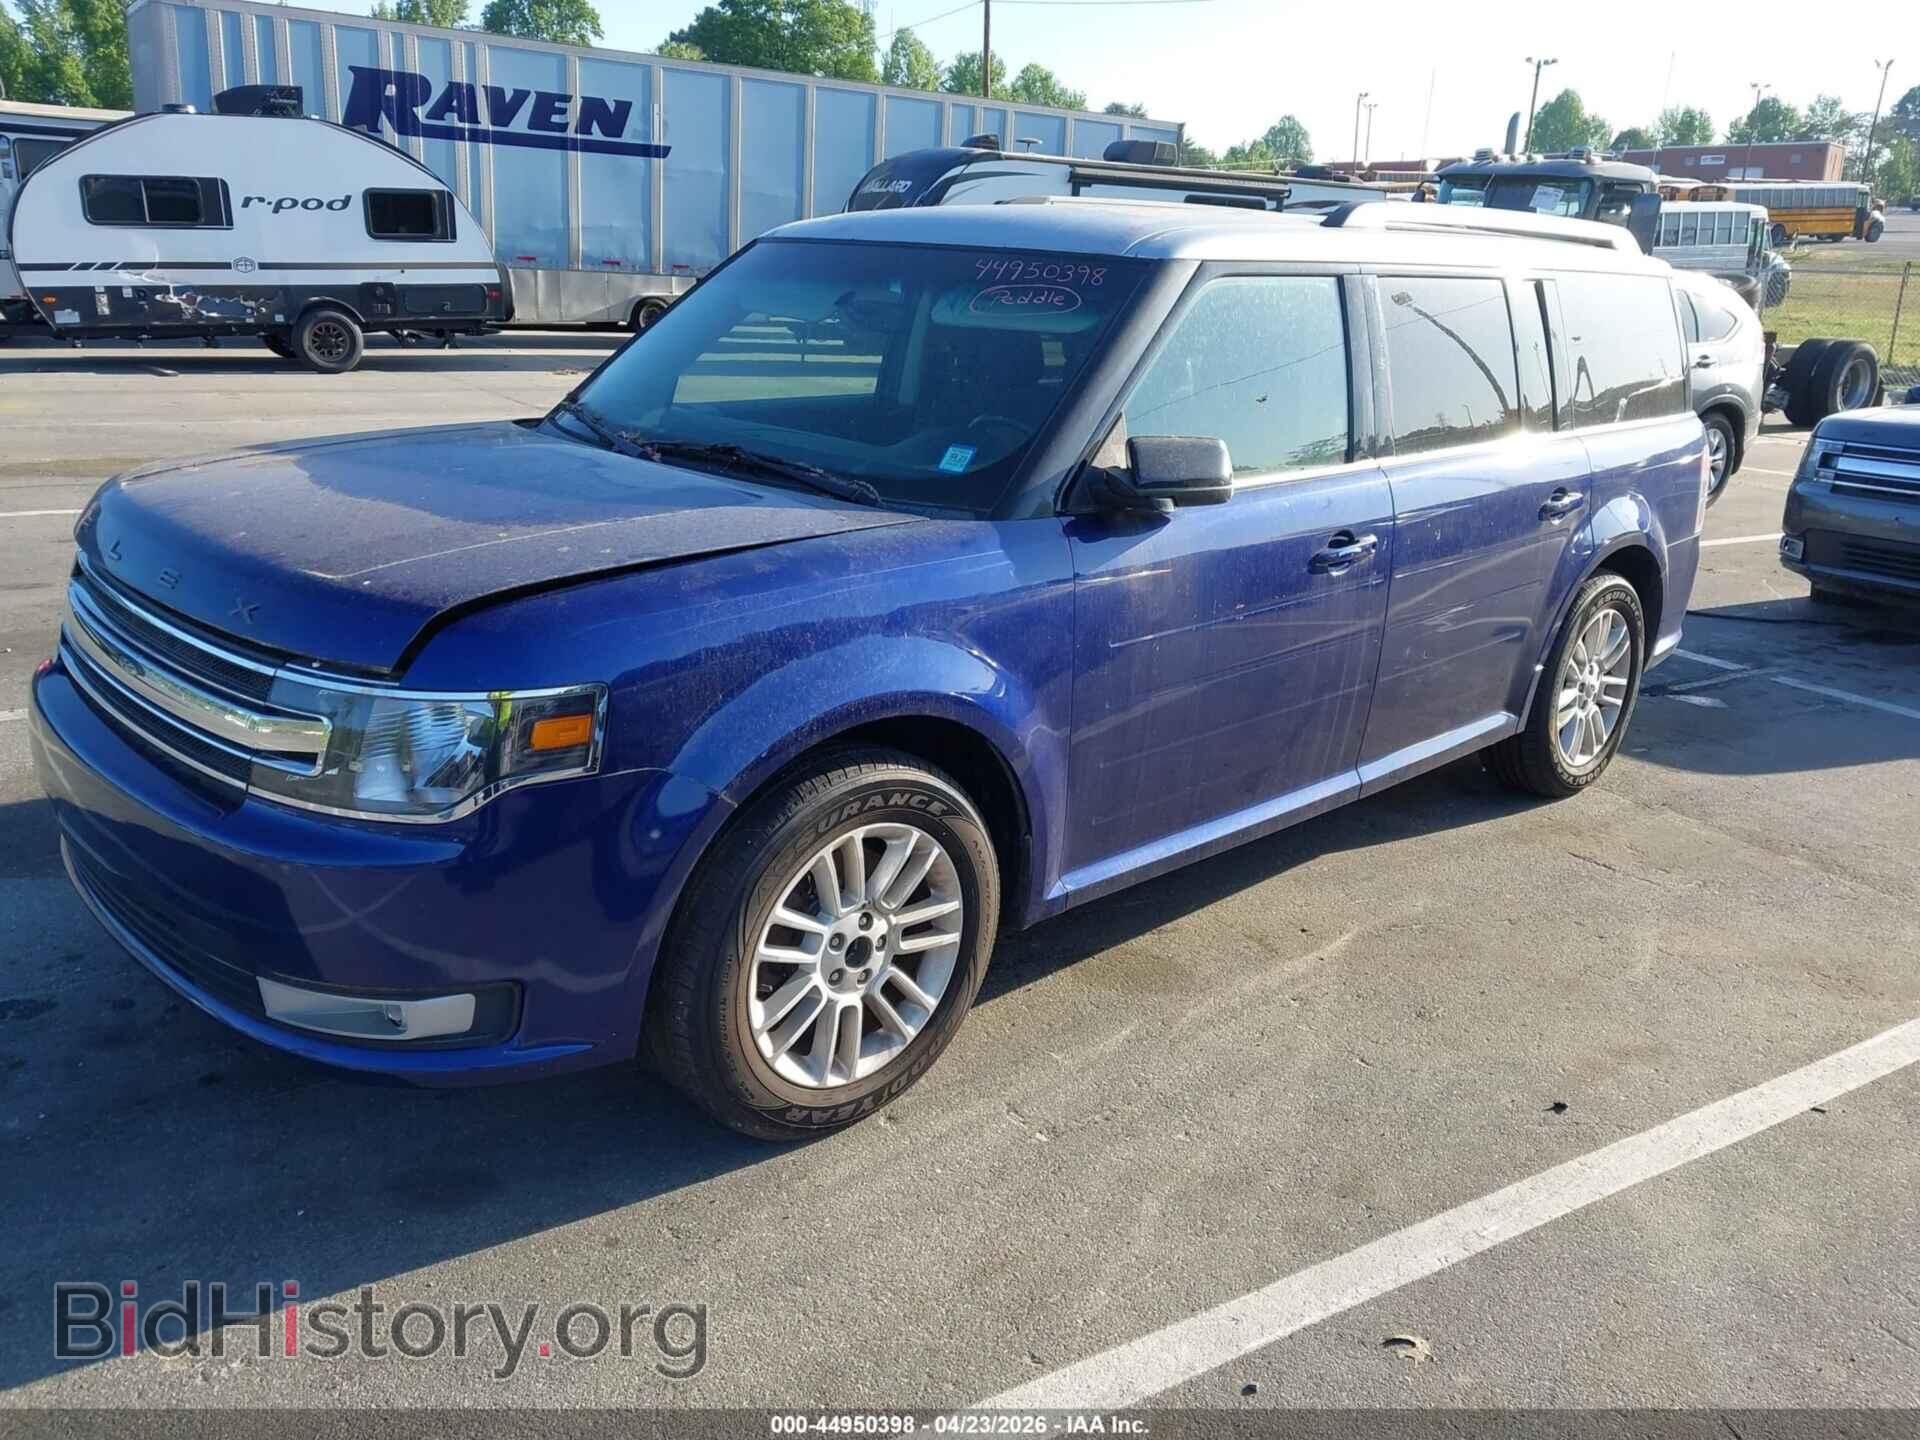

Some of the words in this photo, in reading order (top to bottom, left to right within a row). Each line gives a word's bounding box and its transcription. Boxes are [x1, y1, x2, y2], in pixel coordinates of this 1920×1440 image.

[342, 65, 633, 138] RAVEN
[976, 257, 1107, 286] 44950398
[990, 289, 1065, 306] Peddle
